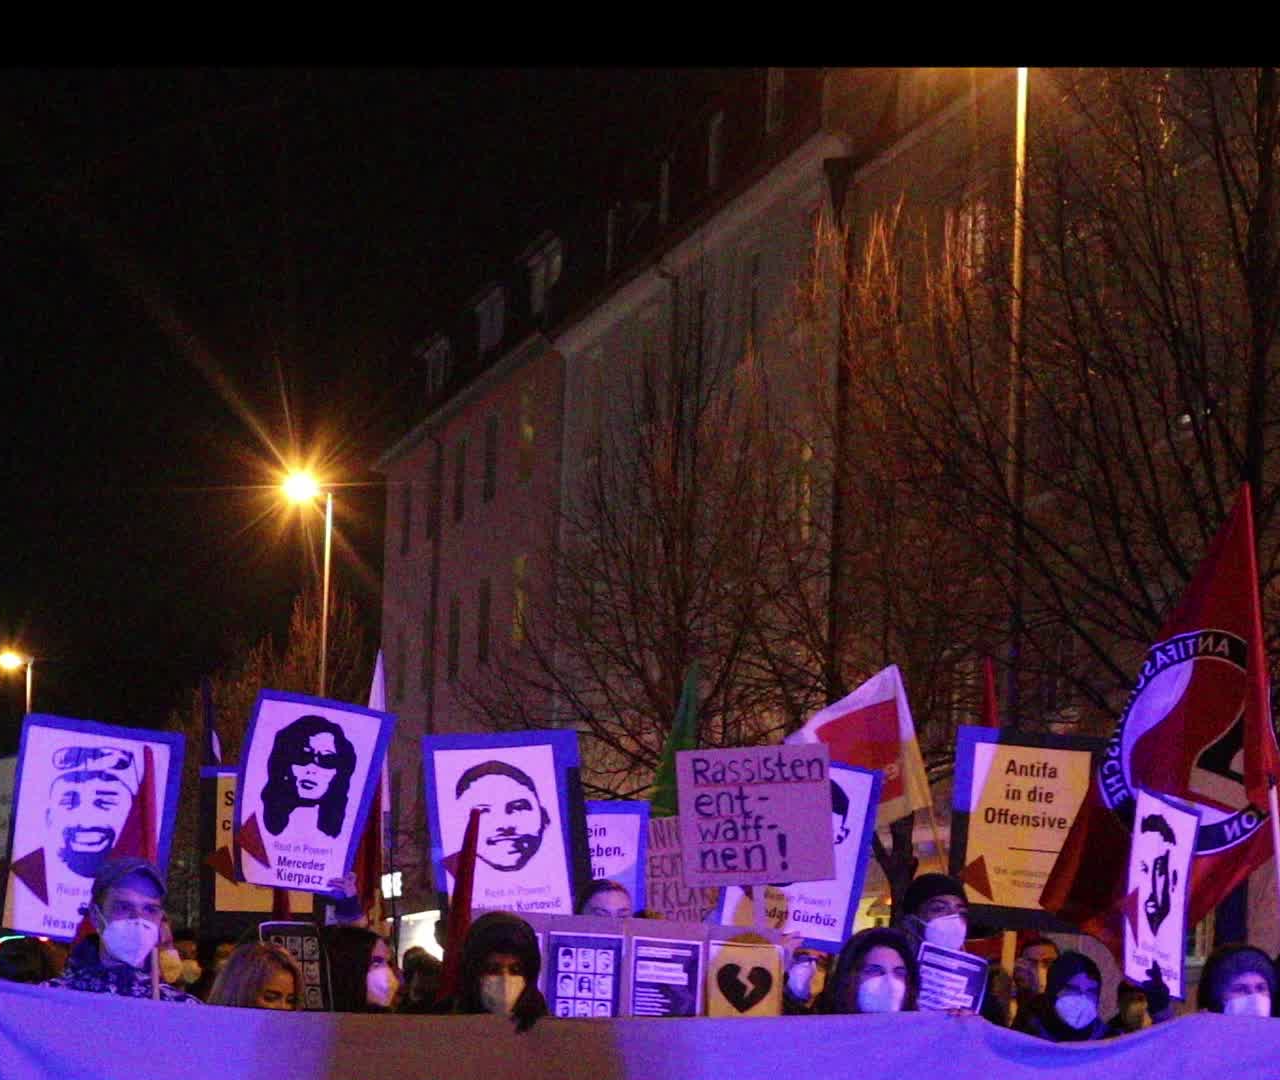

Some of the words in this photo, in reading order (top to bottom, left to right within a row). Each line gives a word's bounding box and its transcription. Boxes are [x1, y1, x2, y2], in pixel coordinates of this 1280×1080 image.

[691, 752, 824, 784] Rassisten
[1005, 759, 1057, 778] Antifa
[694, 786, 769, 817] ent-
[1006, 783, 1021, 801] in
[1027, 786, 1054, 804] die
[984, 806, 1067, 829] Offensive
[699, 815, 778, 842] waff-
[277, 856, 325, 871] Mercedes
[276, 868, 323, 886] Kierpacz
[792, 909, 837, 927] Gürbüz
